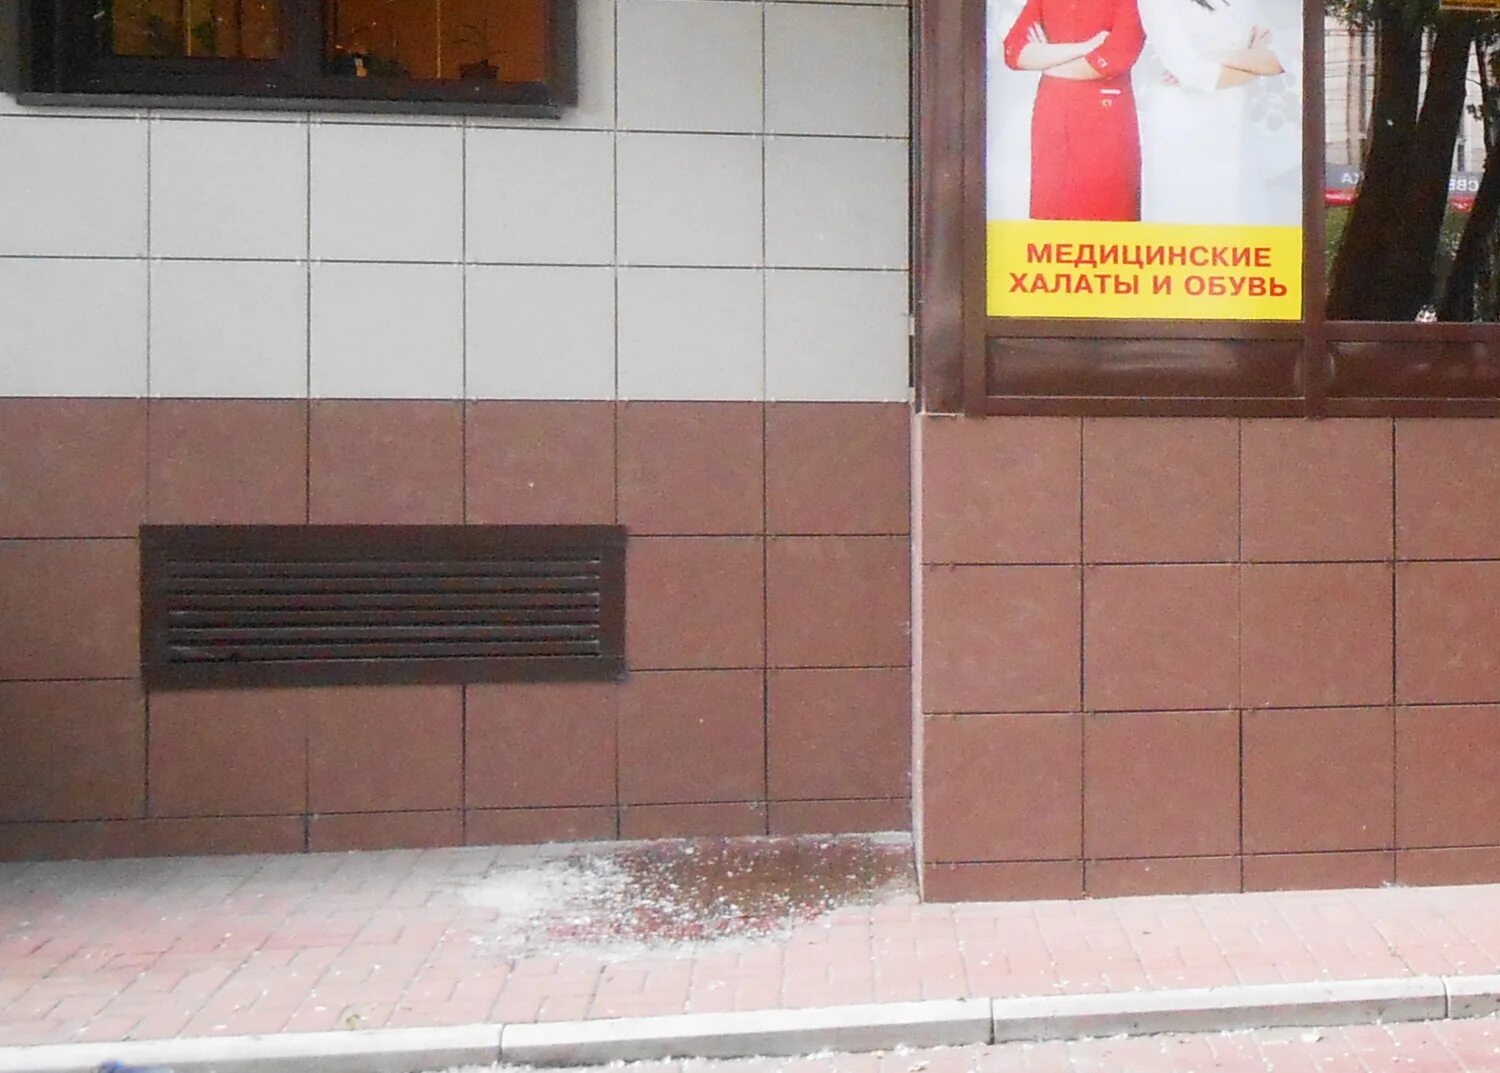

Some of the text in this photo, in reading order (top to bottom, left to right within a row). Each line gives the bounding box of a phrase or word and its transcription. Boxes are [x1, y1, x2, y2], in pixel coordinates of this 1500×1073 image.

[1027, 243, 1272, 269] МЕДИЦИНСКИЕ
[1008, 272, 1288, 297] ХАЛАТЫ И ОБУВЬ
